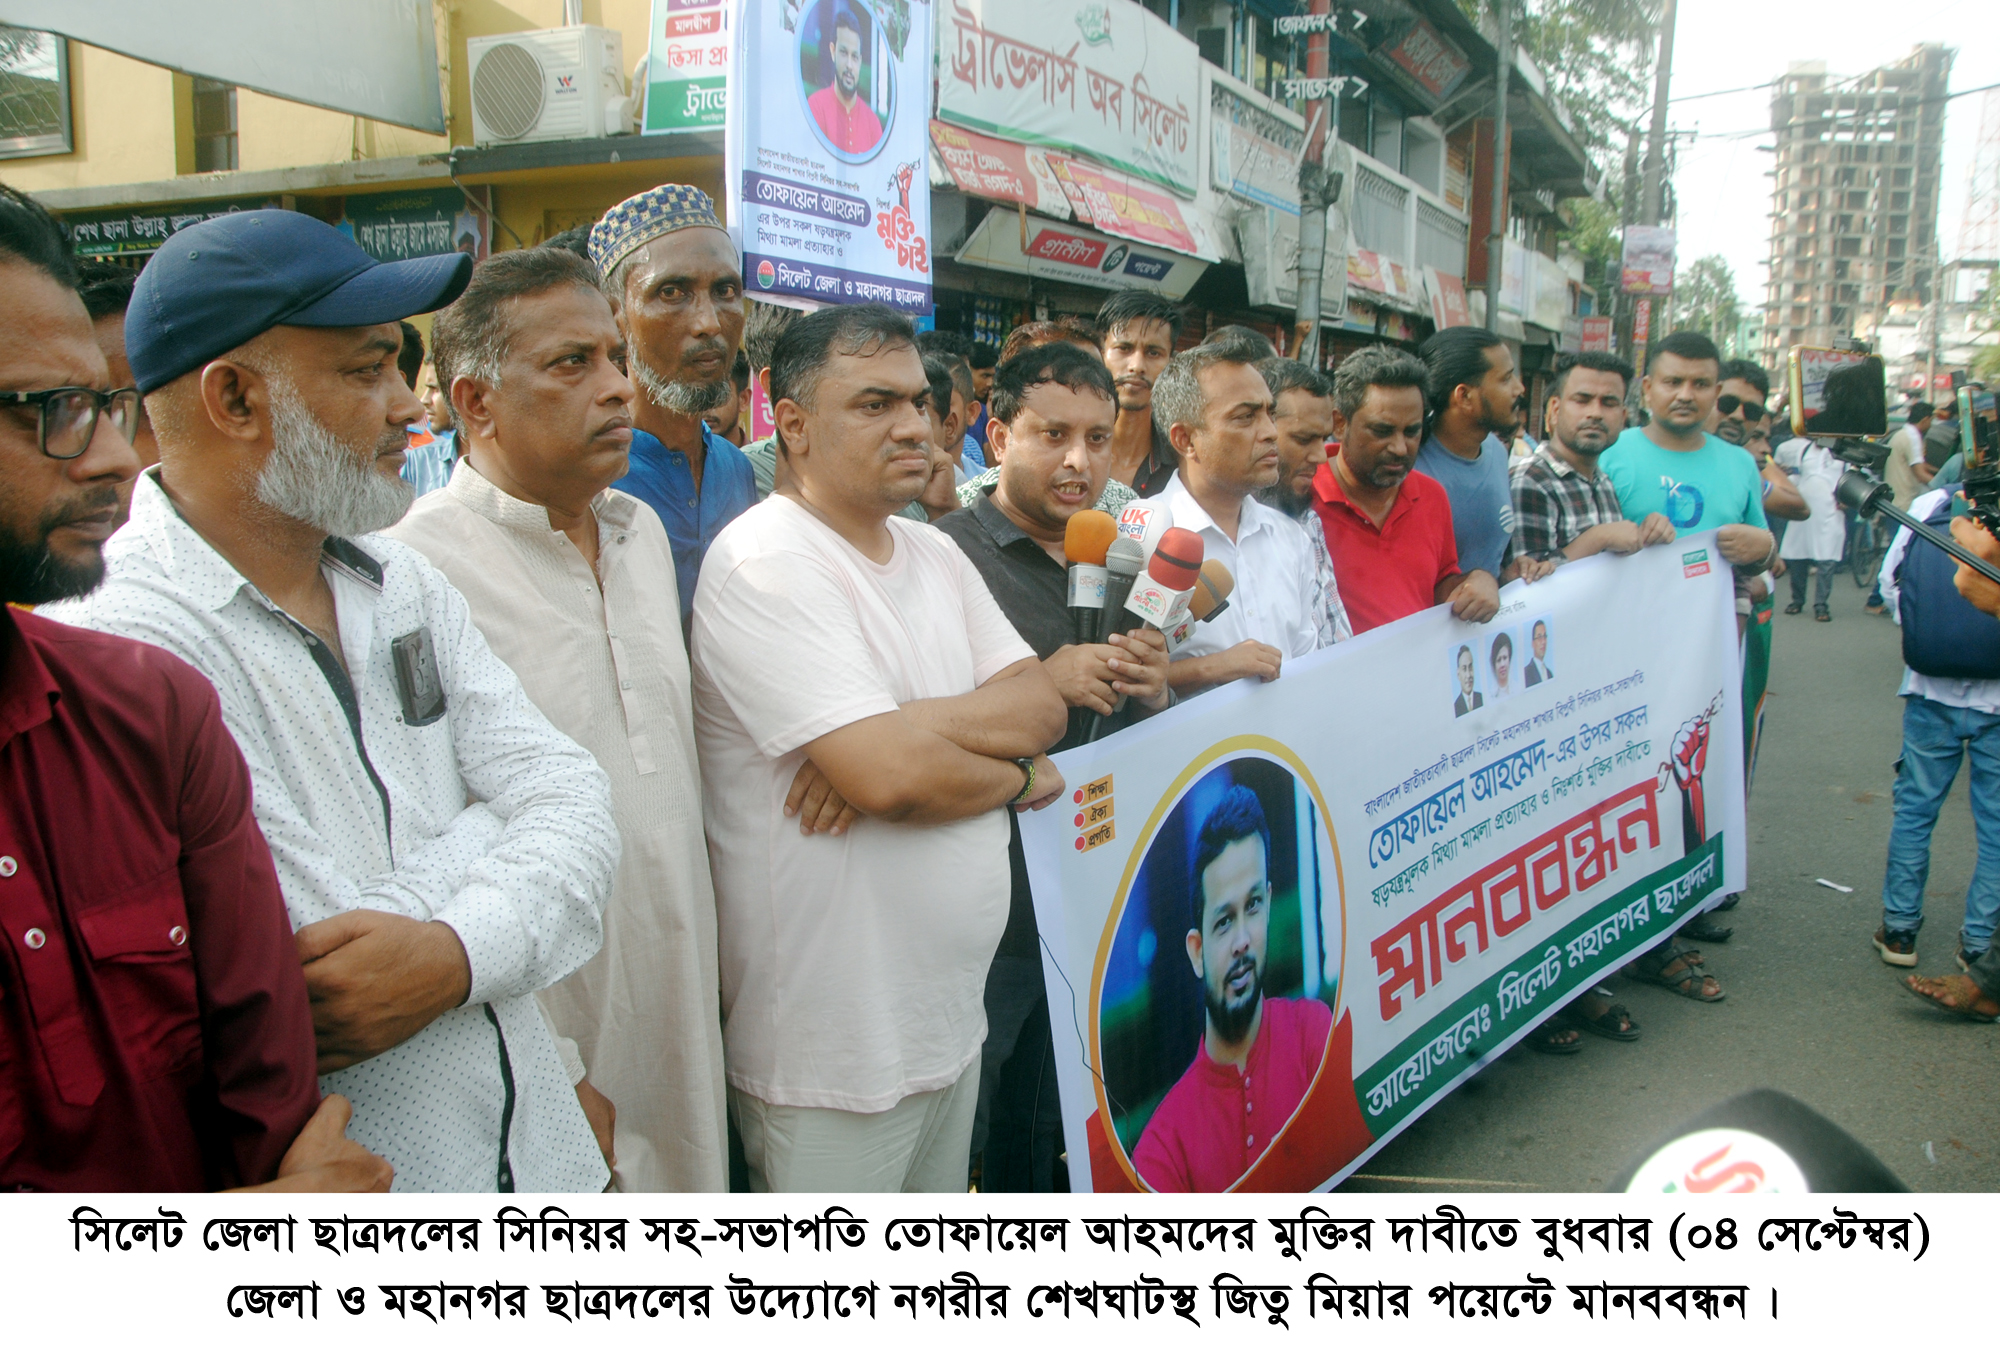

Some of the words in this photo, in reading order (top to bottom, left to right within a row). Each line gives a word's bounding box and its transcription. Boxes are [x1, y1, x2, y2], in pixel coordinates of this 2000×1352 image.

[667, 43, 704, 69] ভিসা
[951, 0, 1081, 113] ট্রাভেলার্স
[1085, 65, 1125, 134] অব
[1131, 71, 1190, 155] সিলেট
[1281, 76, 1349, 100] সাজেক
[757, 179, 818, 211] তোফায়েল
[821, 194, 865, 222] আহমেদ
[73, 222, 99, 242] শেখ
[101, 218, 129, 242] ছানা
[757, 213, 770, 226] এর
[772, 212, 791, 229] উপর
[793, 219, 812, 234] সকল
[876, 205, 915, 251] মুক্তি
[757, 228, 778, 245] মিথ্যা
[780, 235, 802, 250] মামলা
[803, 240, 835, 256] প্রত্যাহার
[837, 246, 843, 257] ও
[898, 236, 929, 273] চাই
[1039, 238, 1096, 262] গ্রামীণ
[778, 262, 812, 289] সিলেট
[815, 275, 842, 295] জেলা
[844, 280, 853, 295] ও
[855, 281, 892, 303] মহানগর
[895, 287, 926, 307] ছাত্রদল
[1118, 523, 1146, 535] বাংলা
[1121, 509, 1150, 525] UK
[1364, 784, 1401, 818] বাংলাদেশ
[1402, 753, 1449, 795] জাতীয়তাবাদী
[1450, 744, 1475, 768] ছাত্রদল
[1477, 730, 1500, 754] সিলেট
[1502, 718, 1531, 741] মহানগর
[1532, 709, 1554, 728] শাখার
[1577, 689, 1601, 710] সিনিয়র
[1603, 669, 1644, 696] সহ-সভাপতি
[1087, 781, 1108, 801] শিক্ষা
[1368, 778, 1466, 870] তোফায়েল
[1470, 735, 1576, 801] আহমেদ-এর
[1579, 722, 1611, 751] উপর
[1614, 704, 1648, 735] সকল
[1089, 805, 1107, 822] ঐক্য
[1371, 855, 1430, 908] ষড়যন্ত্রমূলক
[1431, 842, 1458, 871] মিথ্যা
[1460, 817, 1492, 850] মামলা
[1494, 794, 1537, 830] প্রত্যাহার
[1540, 790, 1549, 805] ও
[1551, 763, 1583, 802] নিঃশর্ত
[1586, 756, 1613, 786] মুক্তির
[1615, 740, 1651, 767] দাবীতে
[1088, 825, 1111, 846] প্রগতি
[1370, 776, 1661, 1022] মানববন্ধন
[1365, 1003, 1492, 1117] আয়োজনেঃ
[1496, 945, 1562, 1022] সিলেট
[1565, 893, 1651, 968] মহানগর
[1652, 852, 1715, 915] ছাত্রদল
